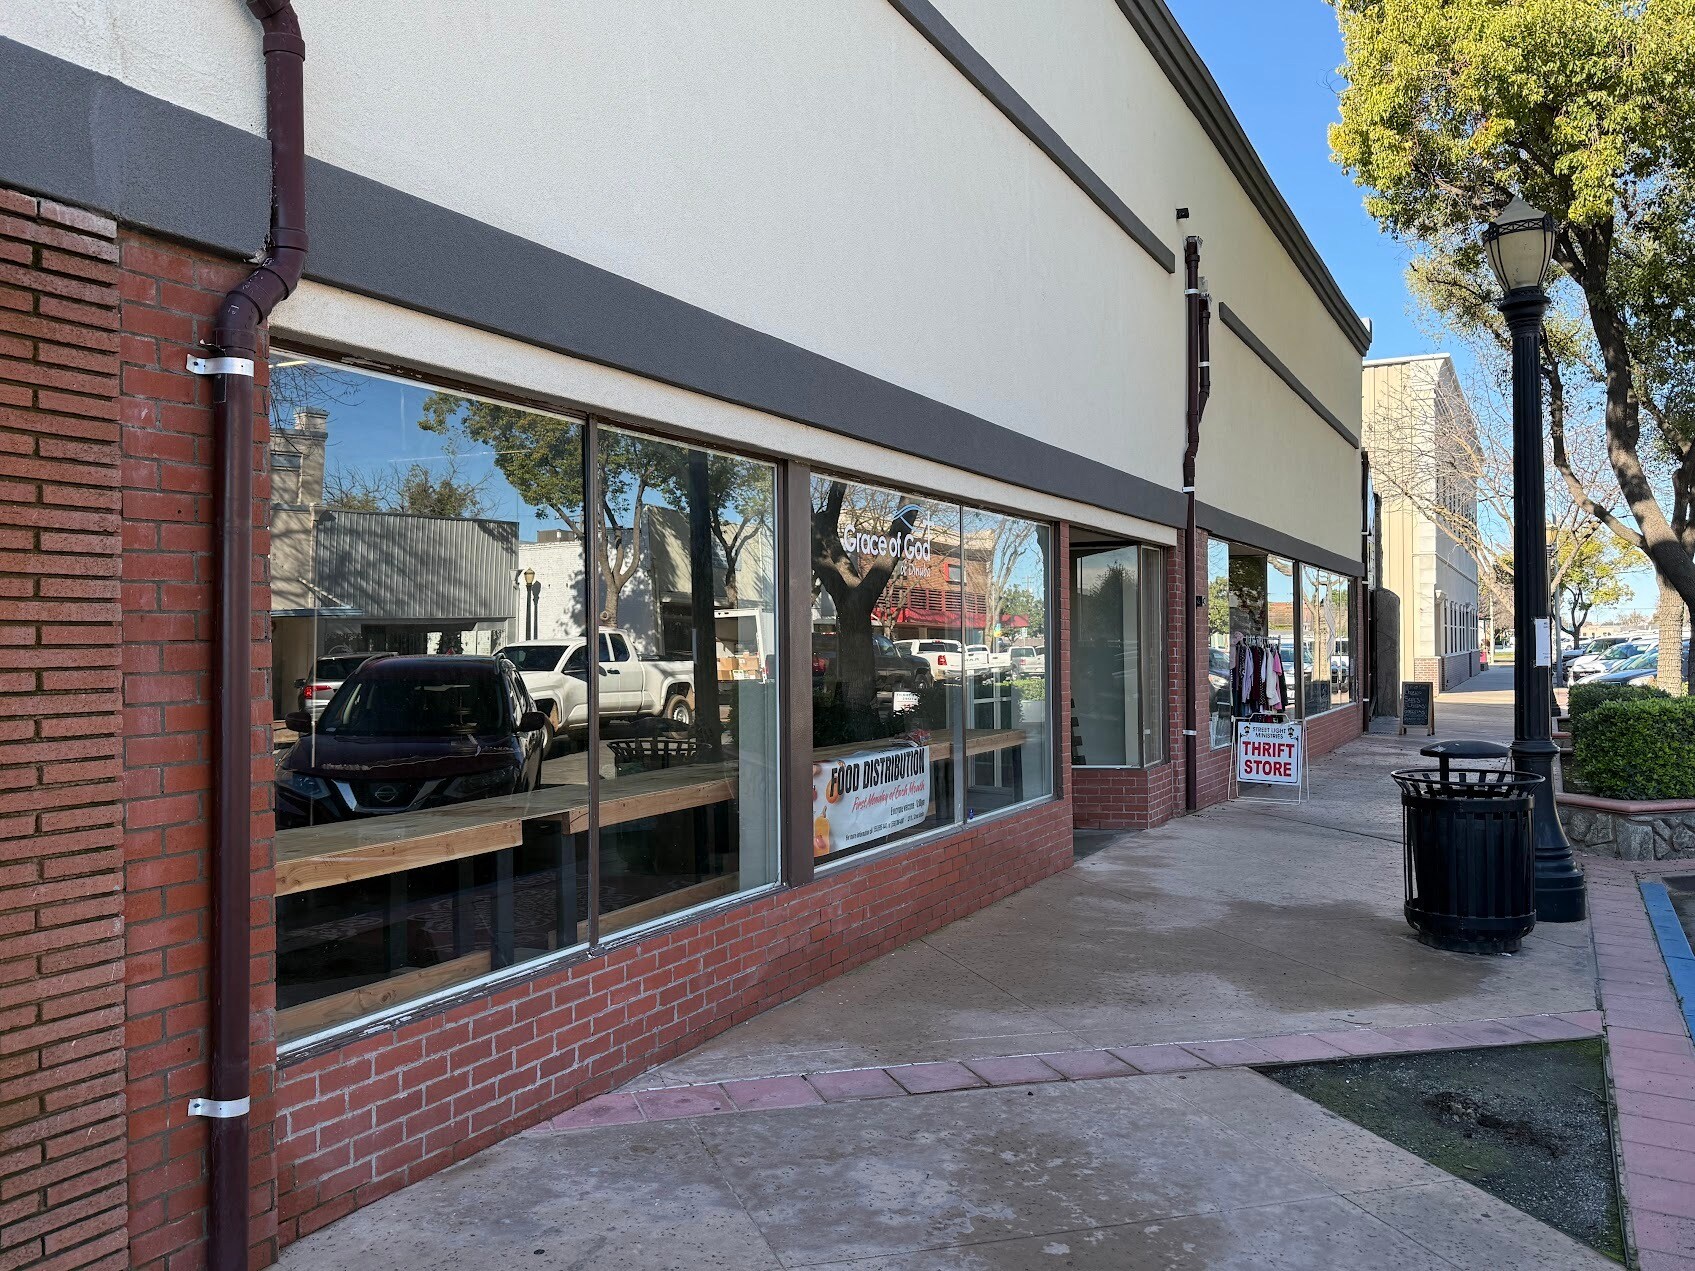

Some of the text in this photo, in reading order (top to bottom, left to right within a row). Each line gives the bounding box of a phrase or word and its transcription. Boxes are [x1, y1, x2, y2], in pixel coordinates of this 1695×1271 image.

[844, 521, 931, 561] Grace of God
[1242, 741, 1295, 758] THRIFT
[829, 748, 925, 797] FOOD DISTRIBUTION
[1244, 759, 1292, 777] STORE
[866, 790, 888, 808] Monday
[889, 790, 896, 801] of
[895, 785, 908, 799] Each
[908, 780, 925, 796] Month
